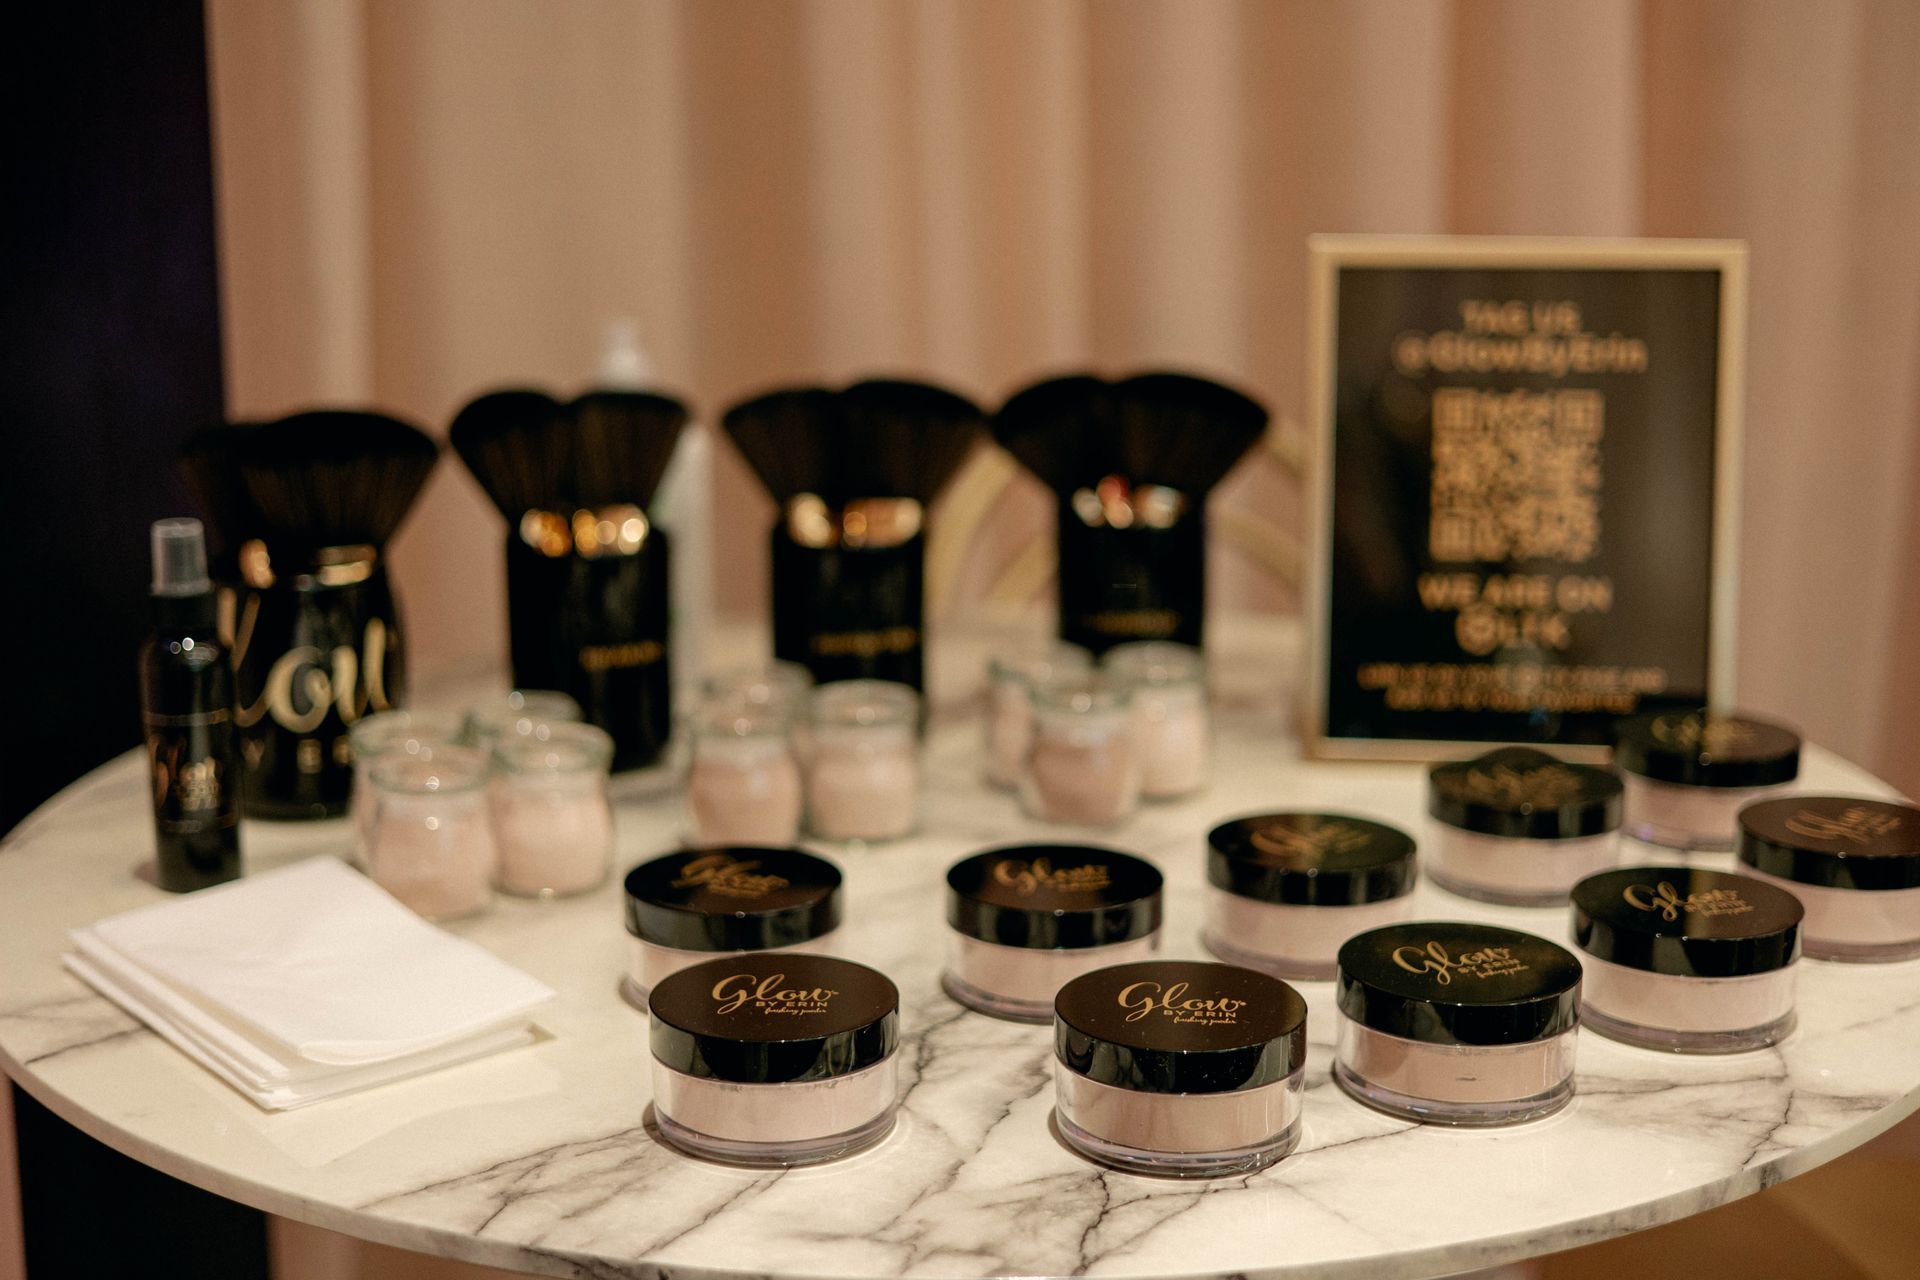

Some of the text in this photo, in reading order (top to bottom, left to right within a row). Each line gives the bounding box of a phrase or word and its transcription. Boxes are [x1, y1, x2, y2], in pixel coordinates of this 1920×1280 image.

[1418, 574, 1480, 611] WE
[1481, 574, 1552, 611] ARE
[1392, 941, 1510, 985] Glow
[712, 973, 839, 1015] Glow
[1118, 981, 1247, 1022] Glow
[1194, 1010, 1237, 1018] ERIN
